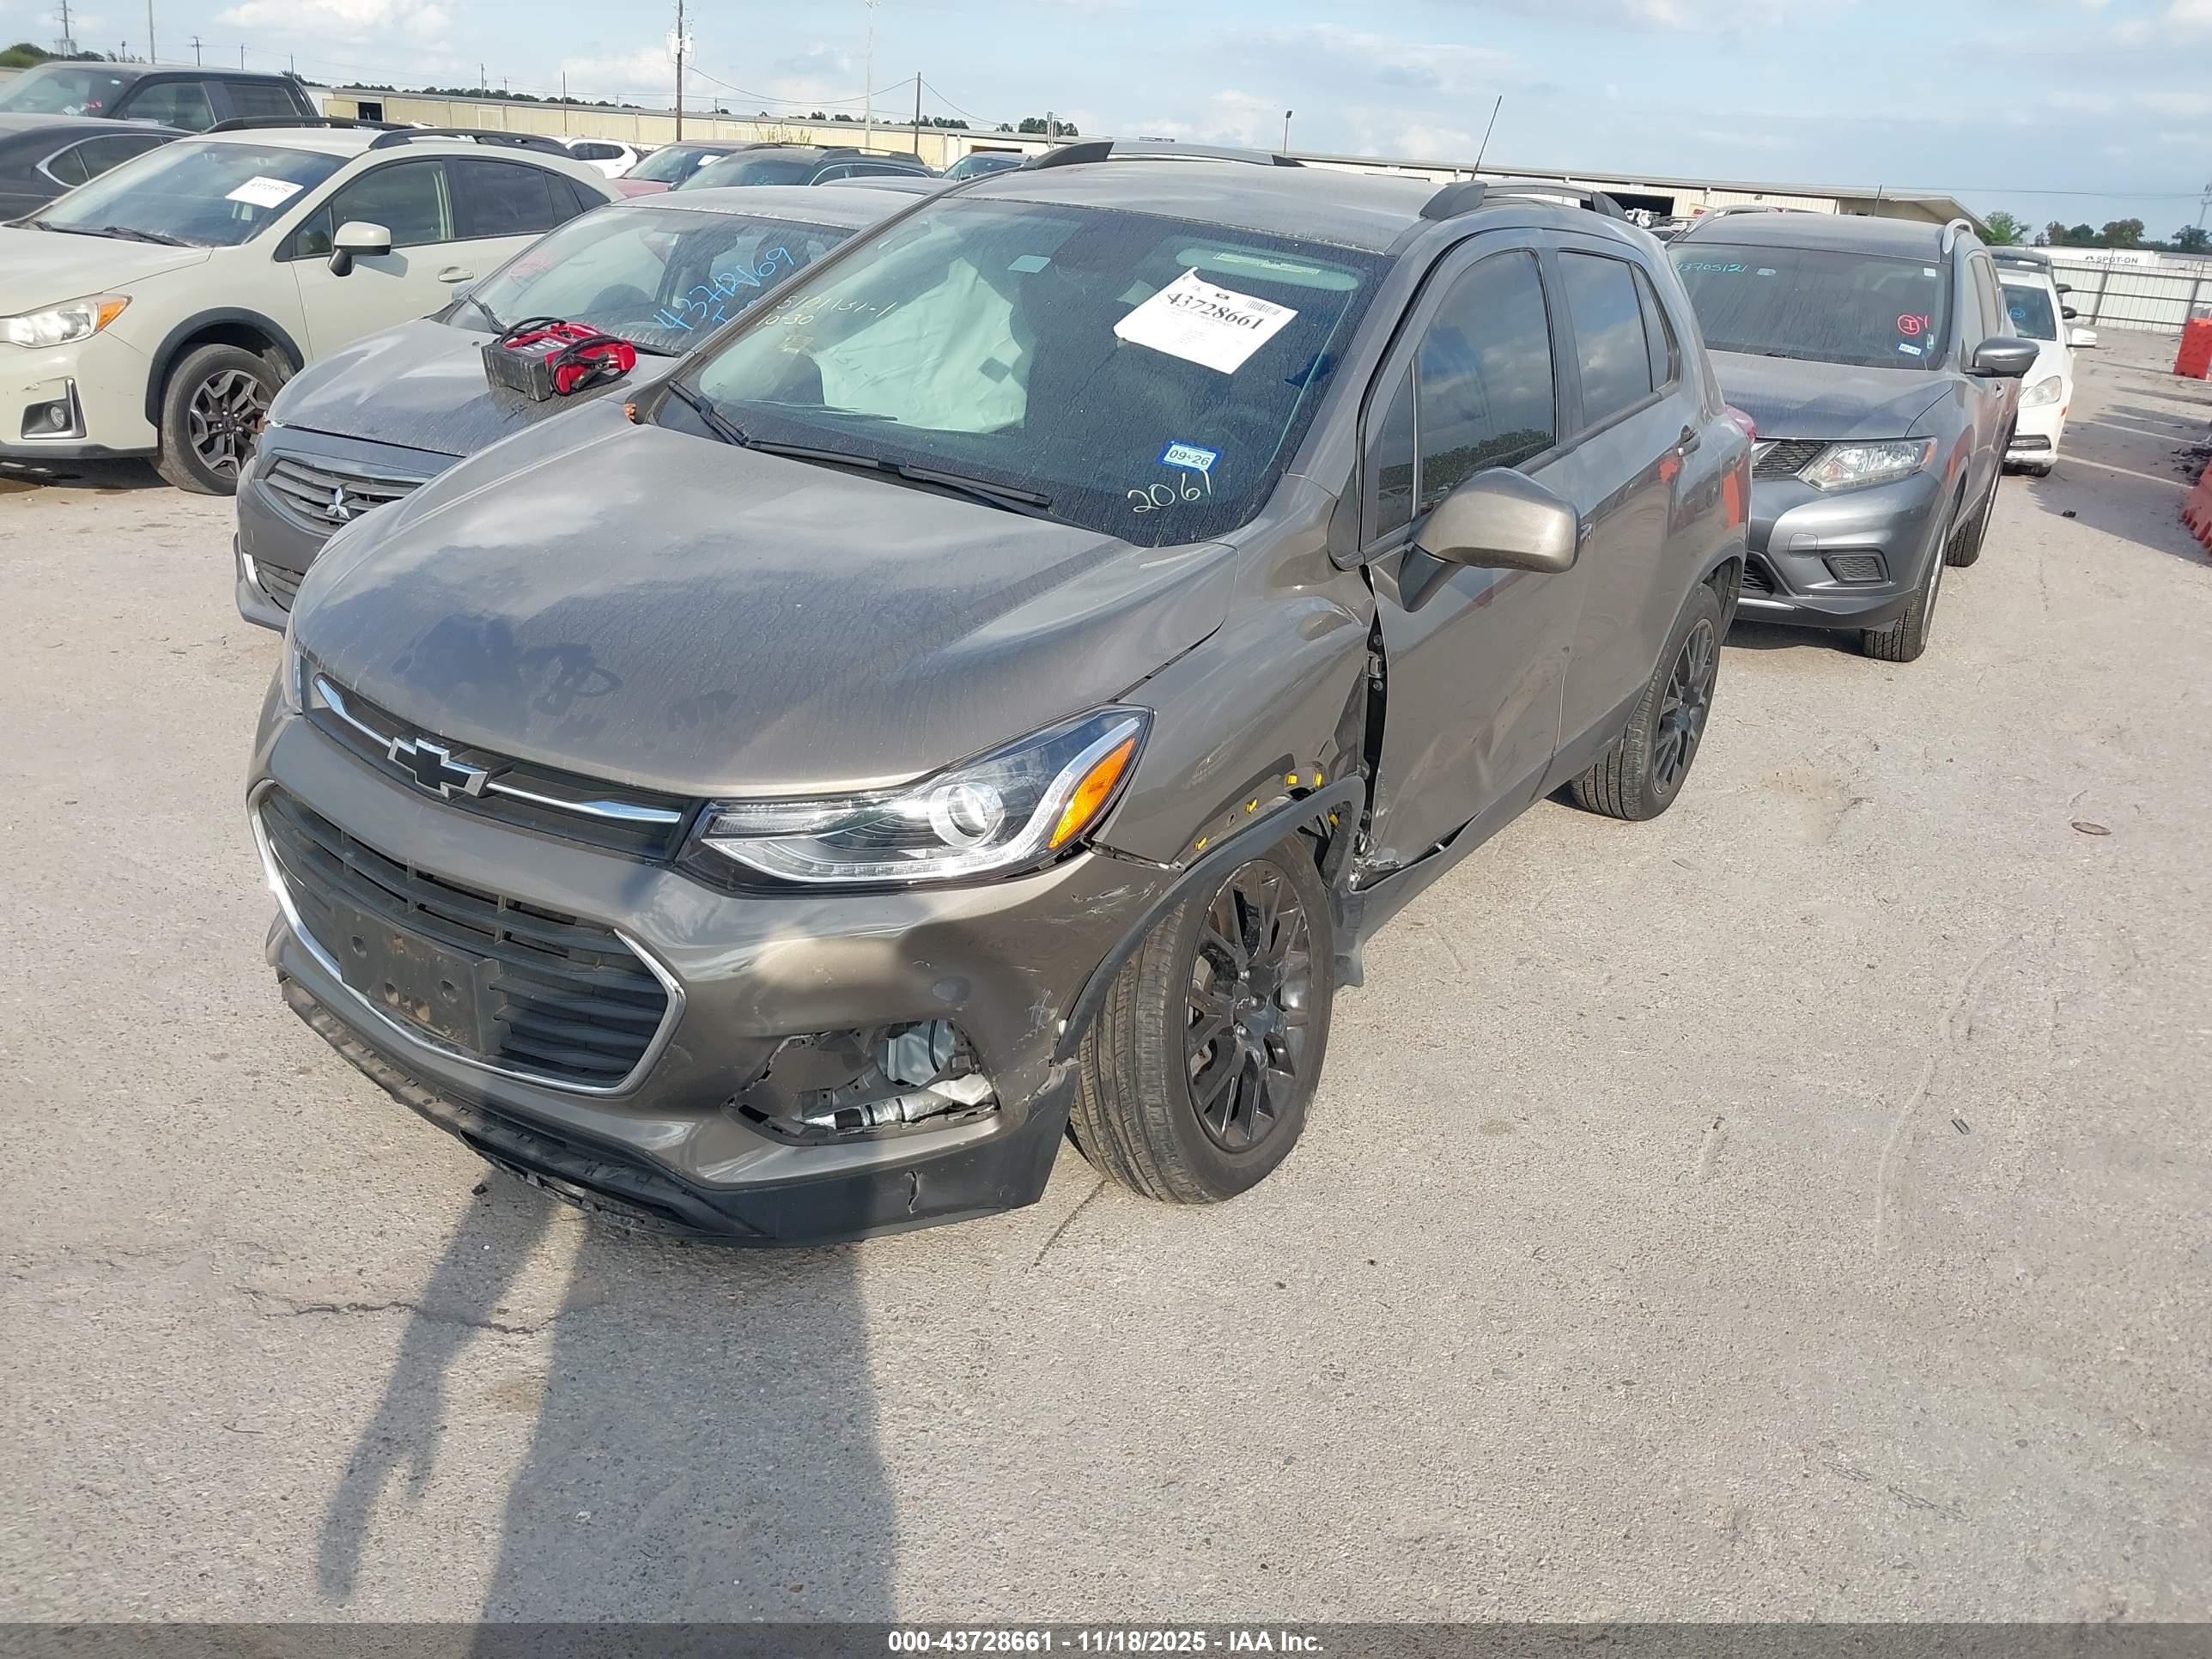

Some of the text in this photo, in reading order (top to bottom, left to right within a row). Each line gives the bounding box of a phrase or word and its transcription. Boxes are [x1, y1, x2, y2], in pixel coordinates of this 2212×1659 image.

[1166, 292, 1265, 330] 43728661
[1169, 449, 1212, 466] 09 26
[1127, 469, 1212, 513] 2061
